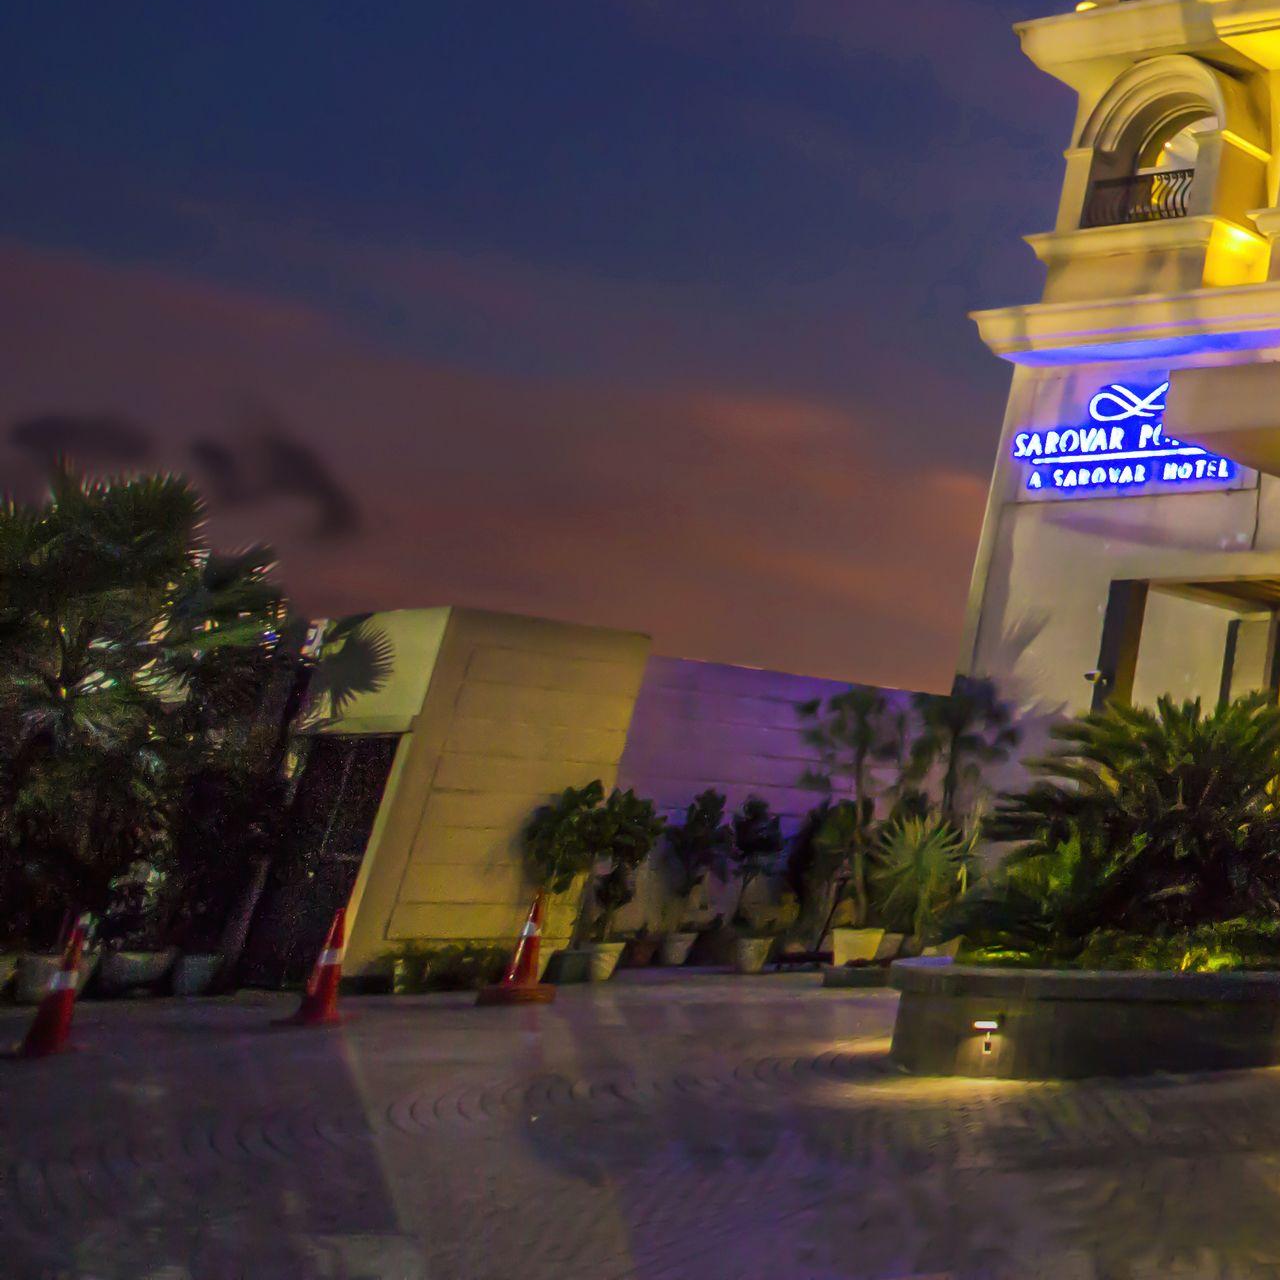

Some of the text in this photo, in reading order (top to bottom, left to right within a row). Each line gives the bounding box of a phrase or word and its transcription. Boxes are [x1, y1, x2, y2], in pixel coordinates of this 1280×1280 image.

[1013, 426, 1125, 457] SAROVAR
[1028, 458, 1229, 489] A SAROVAR HOTEL
